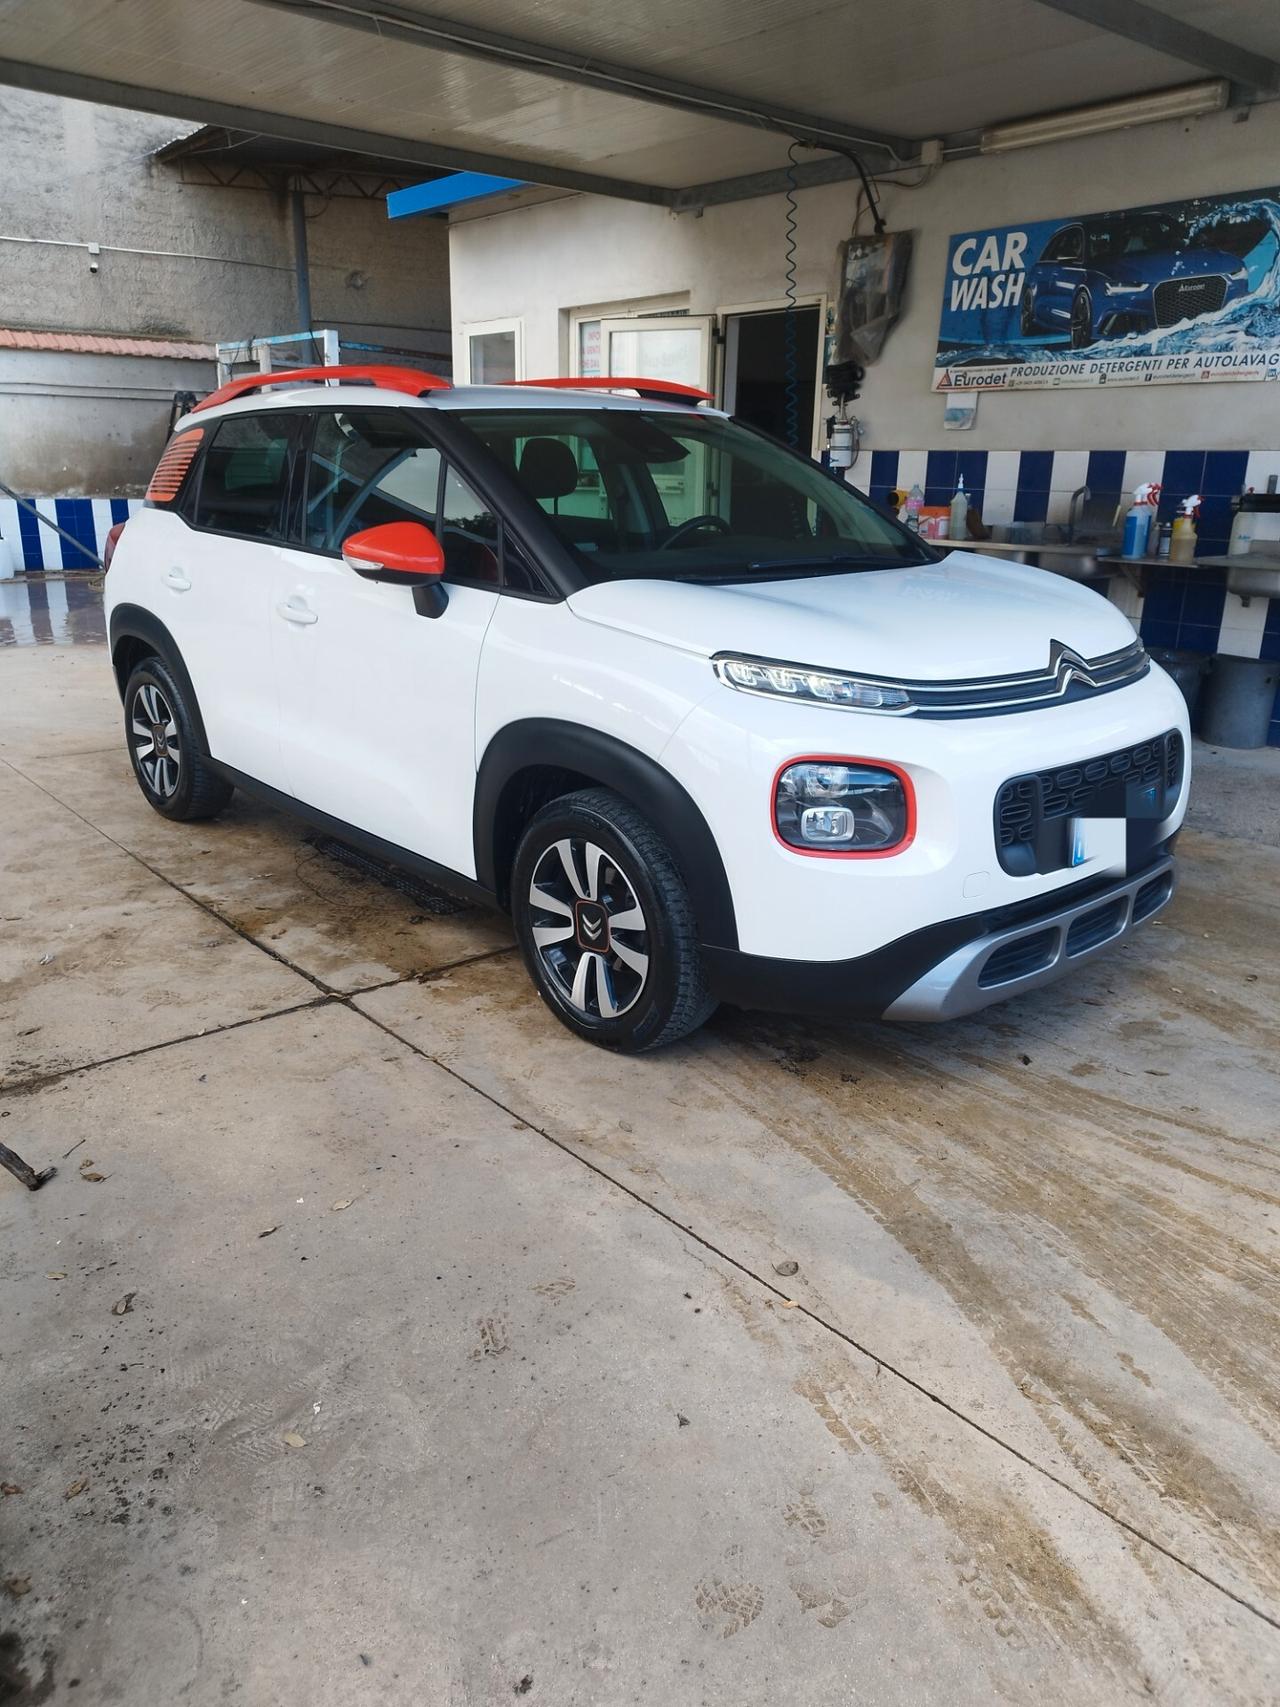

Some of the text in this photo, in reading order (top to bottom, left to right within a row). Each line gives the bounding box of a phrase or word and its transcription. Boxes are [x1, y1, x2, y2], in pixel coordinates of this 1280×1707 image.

[952, 232, 1028, 276] CAR
[950, 272, 1026, 312] WASH
[954, 372, 1007, 387] Eurodet
[1010, 363, 1086, 377] PRODUZIONE
[1089, 359, 1163, 374] DETERGENTI
[1166, 357, 1190, 370] PER
[1193, 353, 1280, 369] AUTOLAVAG
